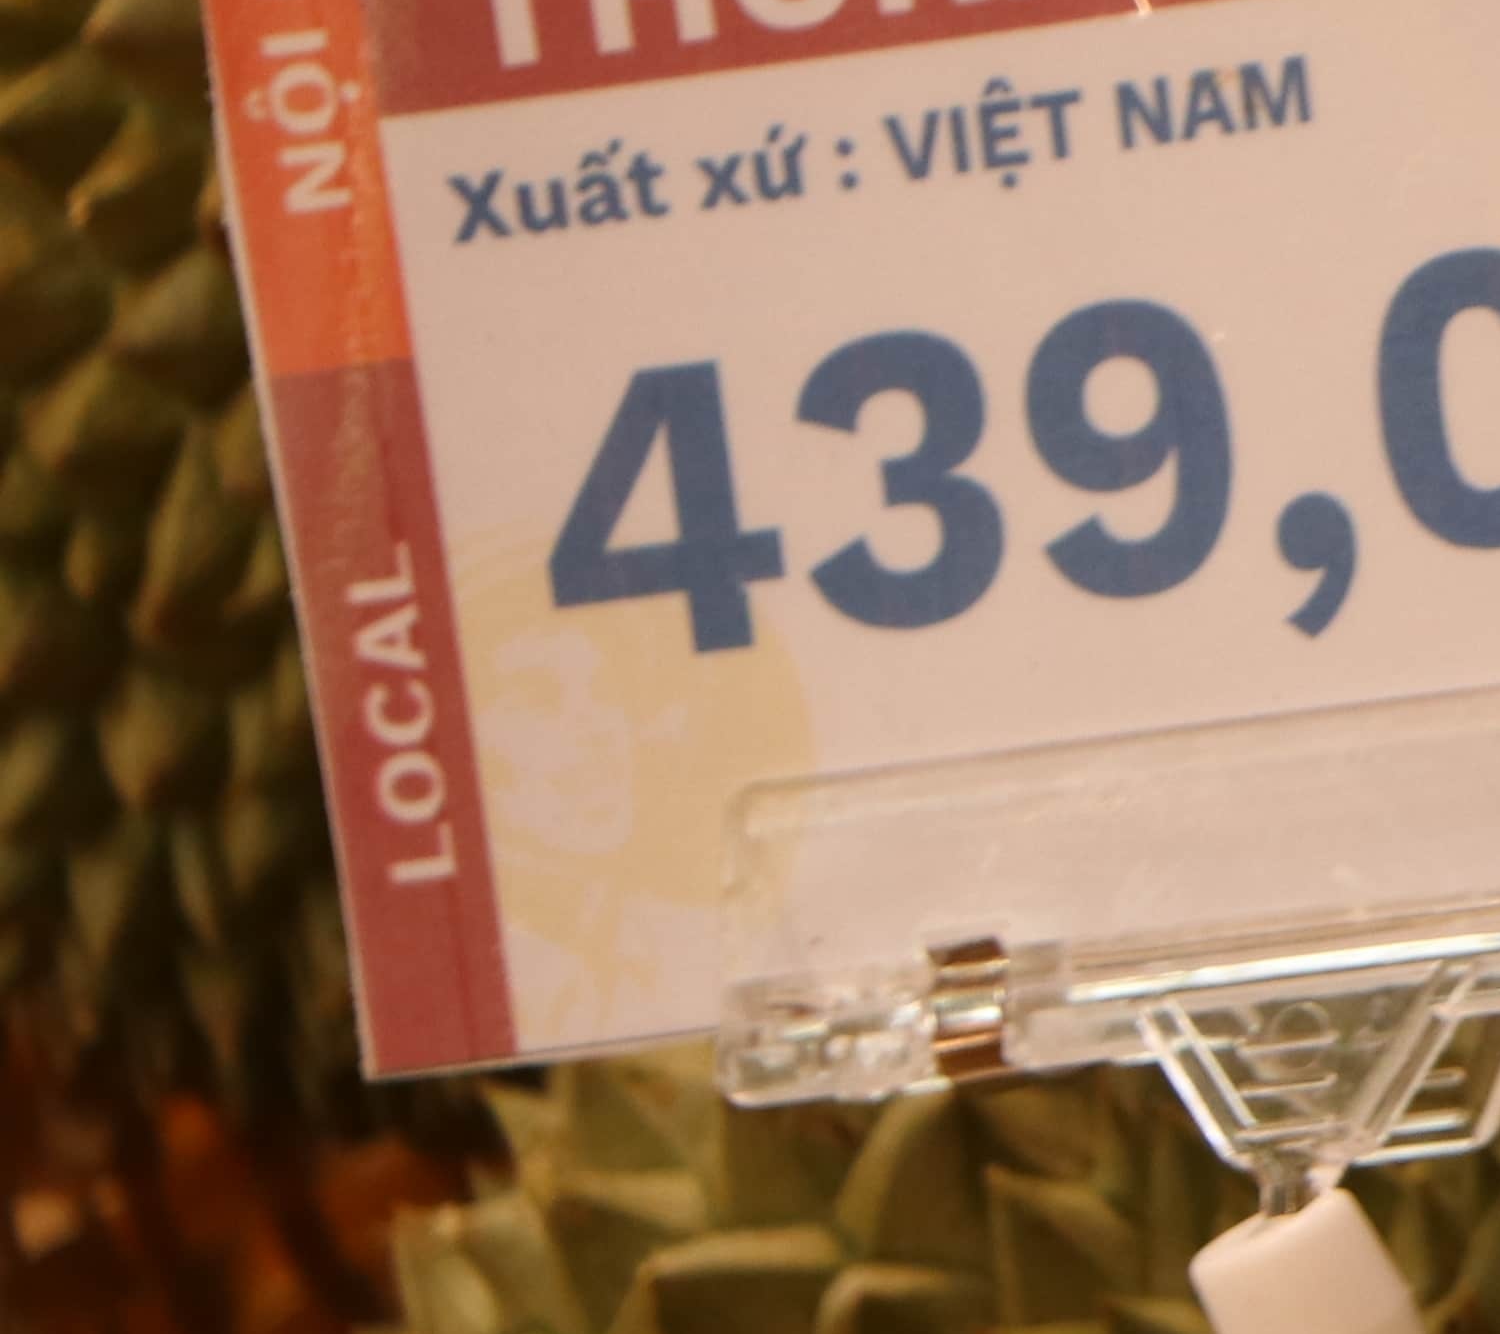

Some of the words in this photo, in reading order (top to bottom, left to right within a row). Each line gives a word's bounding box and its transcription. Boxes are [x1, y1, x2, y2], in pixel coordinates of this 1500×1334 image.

[243, 29, 362, 214] NỘI
[447, 139, 670, 244] Xuất
[697, 124, 809, 210] xứ
[883, 76, 1083, 188] VIỆT
[1115, 55, 1314, 150] NAM
[346, 540, 457, 884] LOCAL
